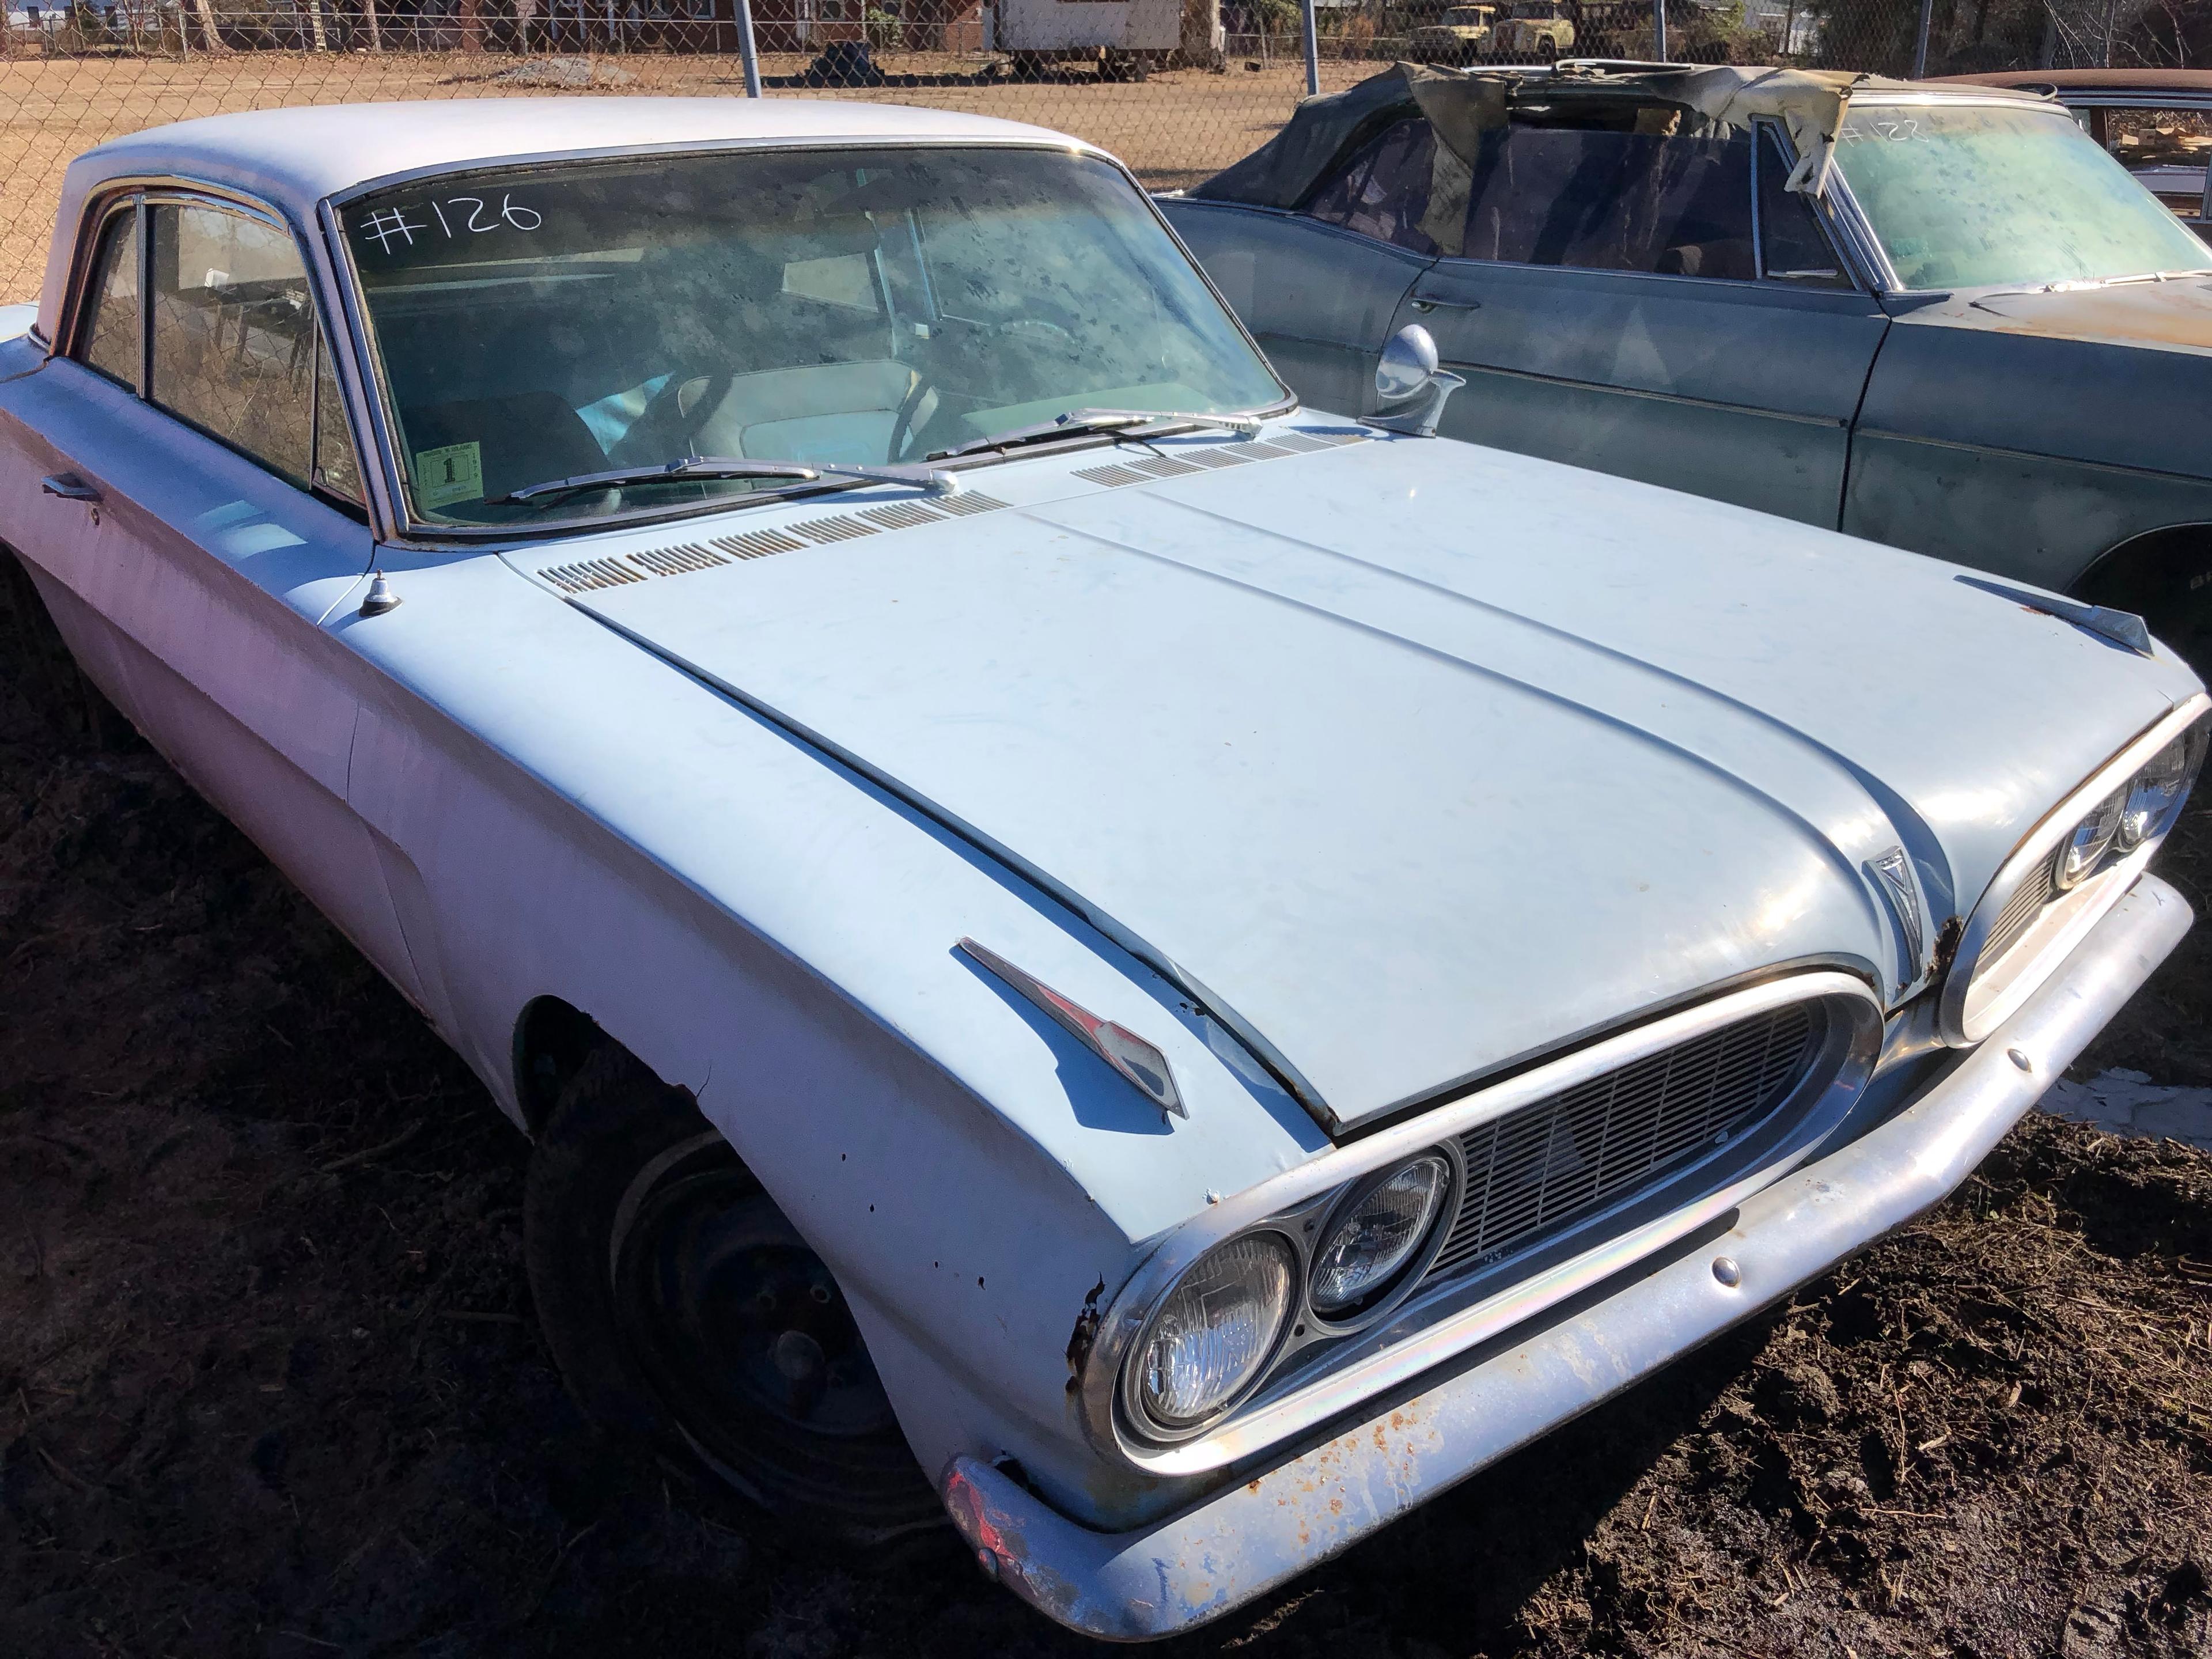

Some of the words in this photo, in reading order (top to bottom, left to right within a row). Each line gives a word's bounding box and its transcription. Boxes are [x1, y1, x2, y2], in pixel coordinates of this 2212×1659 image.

[1840, 119, 1929, 147] #128
[361, 194, 541, 255] #126
[444, 457, 456, 483] 1
